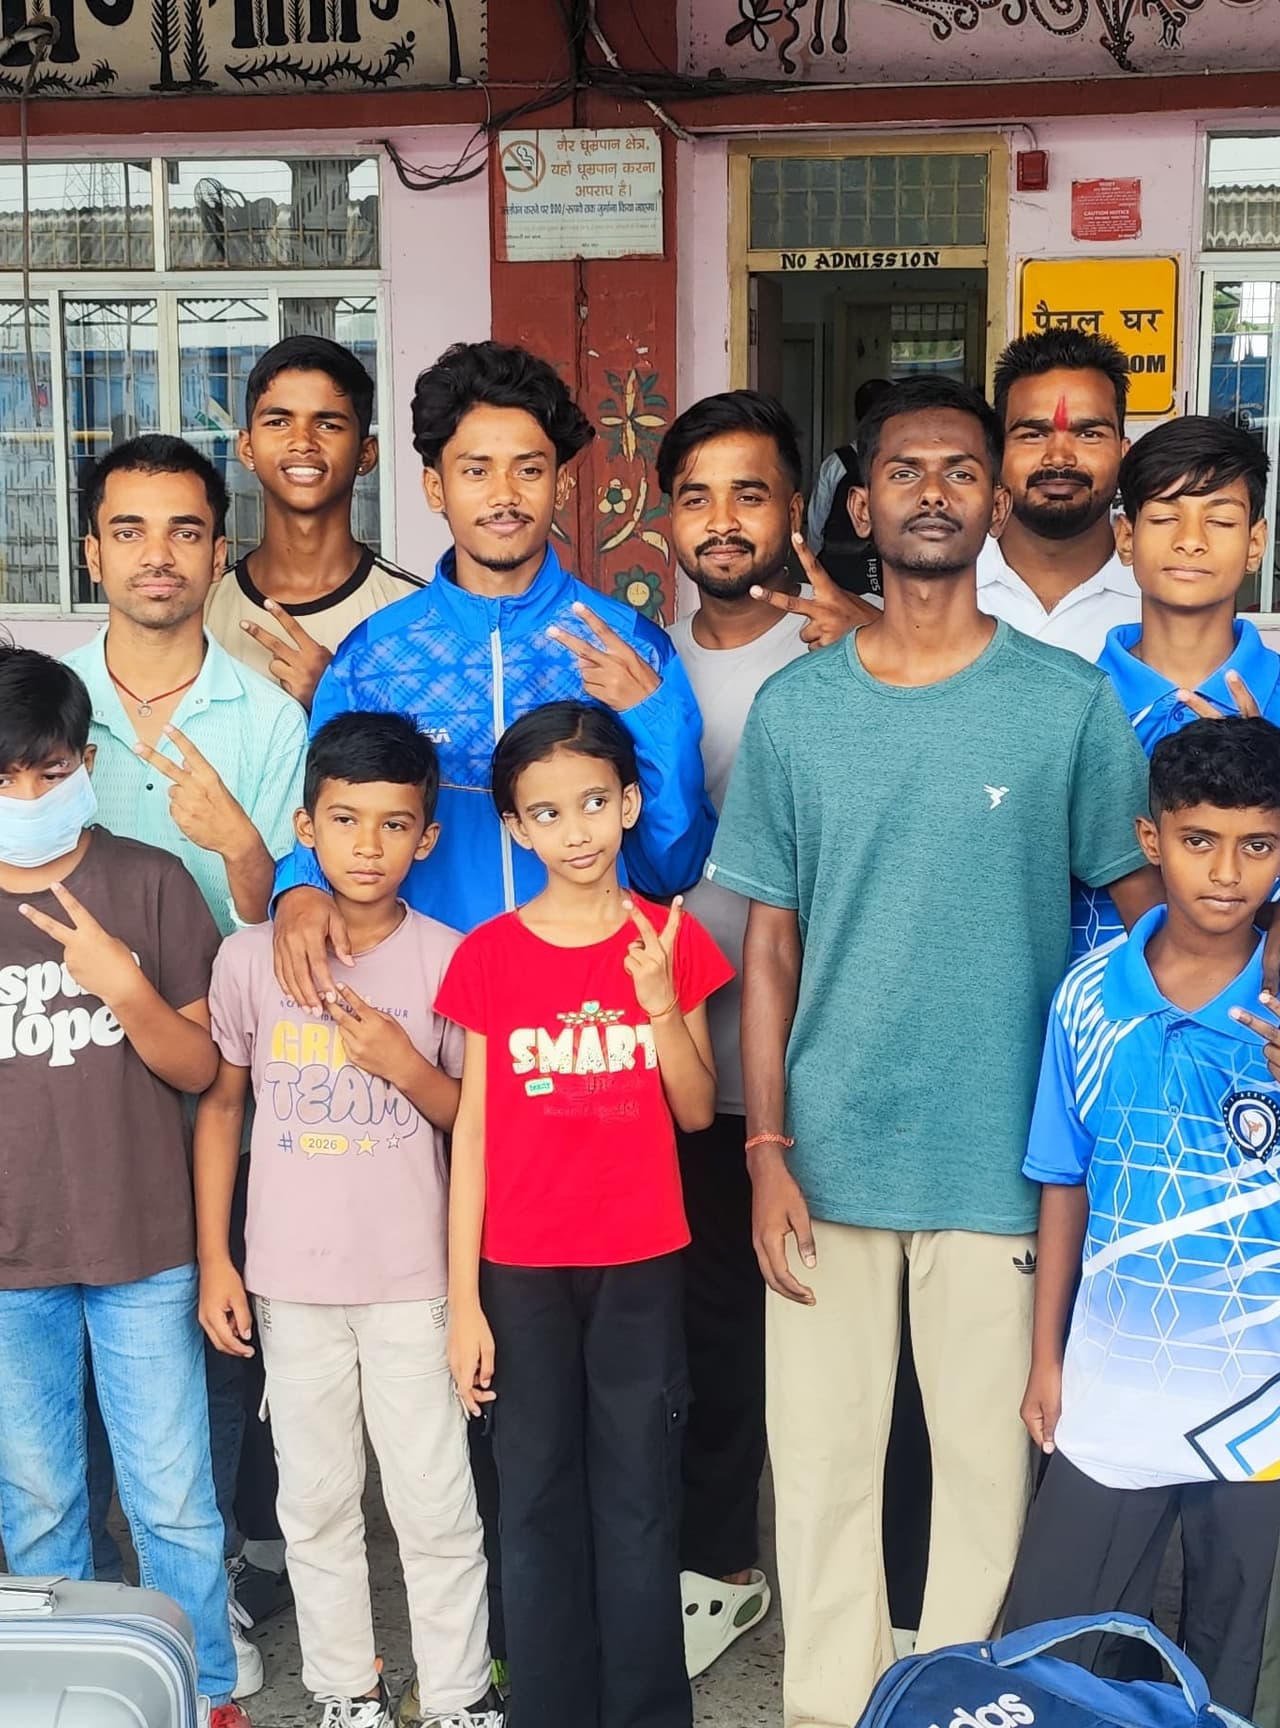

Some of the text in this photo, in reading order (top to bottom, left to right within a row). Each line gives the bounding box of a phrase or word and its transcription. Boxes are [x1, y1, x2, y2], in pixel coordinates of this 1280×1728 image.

[780, 251, 940, 270] NO ADMISSION
[1031, 299, 1164, 333] पैनल घर
[1127, 354, 1166, 373] OM
[867, 558, 881, 592] safari
[508, 1024, 658, 1075] SMART
[264, 1061, 412, 1126] TEAM
[308, 1138, 338, 1150] 2026
